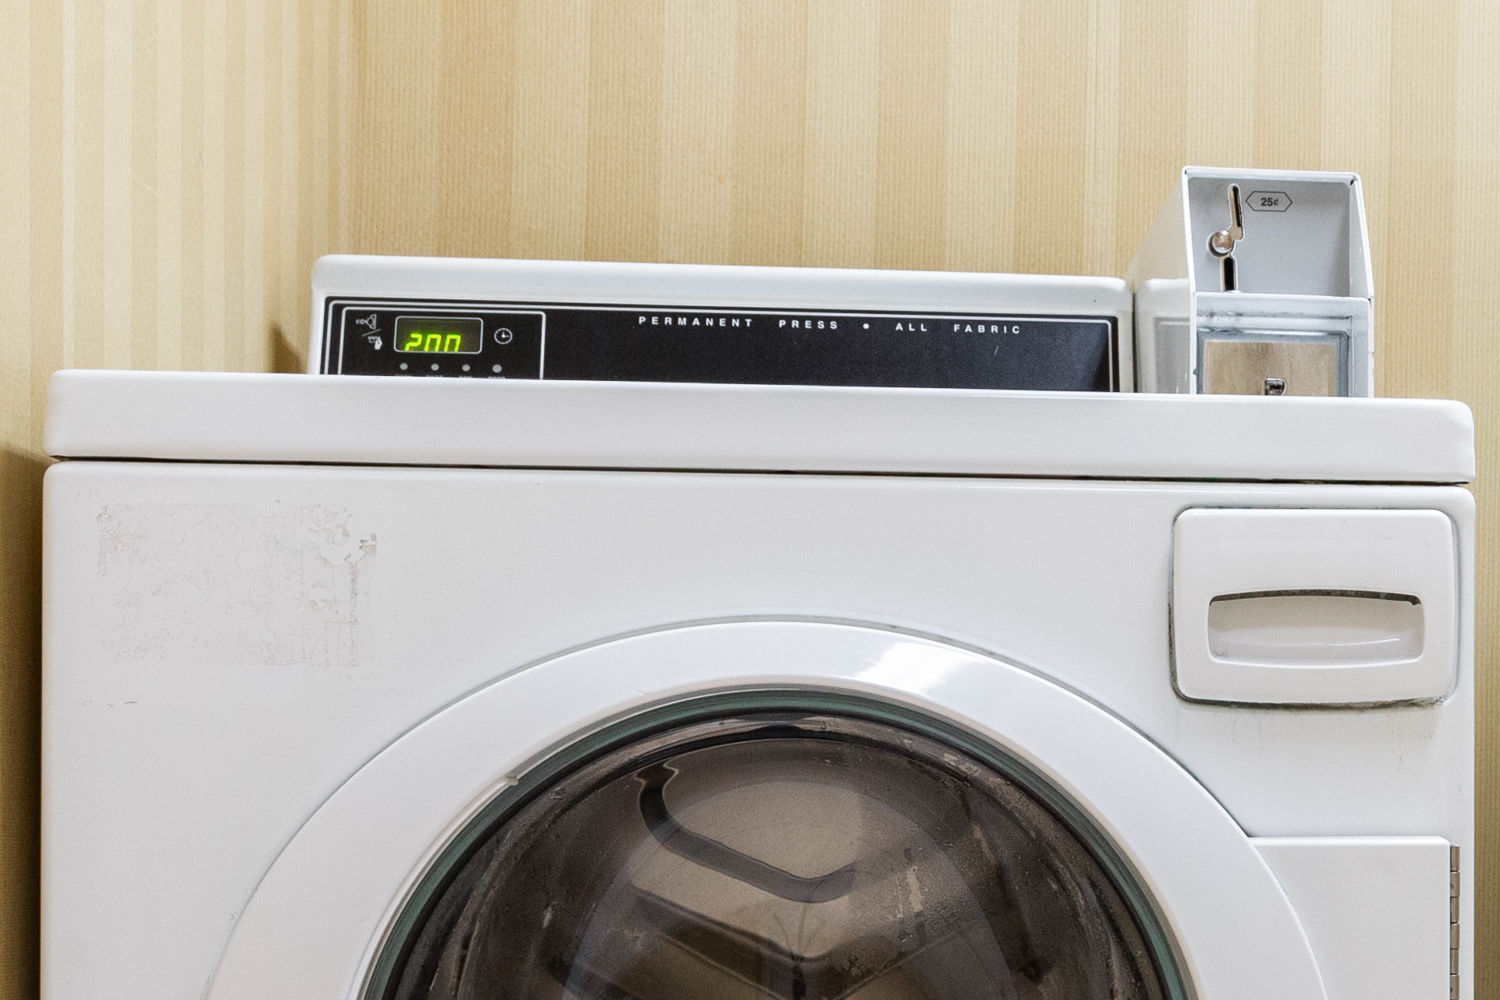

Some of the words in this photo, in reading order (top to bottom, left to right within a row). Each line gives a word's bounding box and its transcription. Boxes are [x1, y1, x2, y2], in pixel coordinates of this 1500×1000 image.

[638, 316, 752, 328] PERMANENT
[778, 319, 838, 330] PRESS
[895, 322, 928, 332] ALL
[953, 324, 1020, 334] FABRIC
[404, 333, 461, 352] 200
